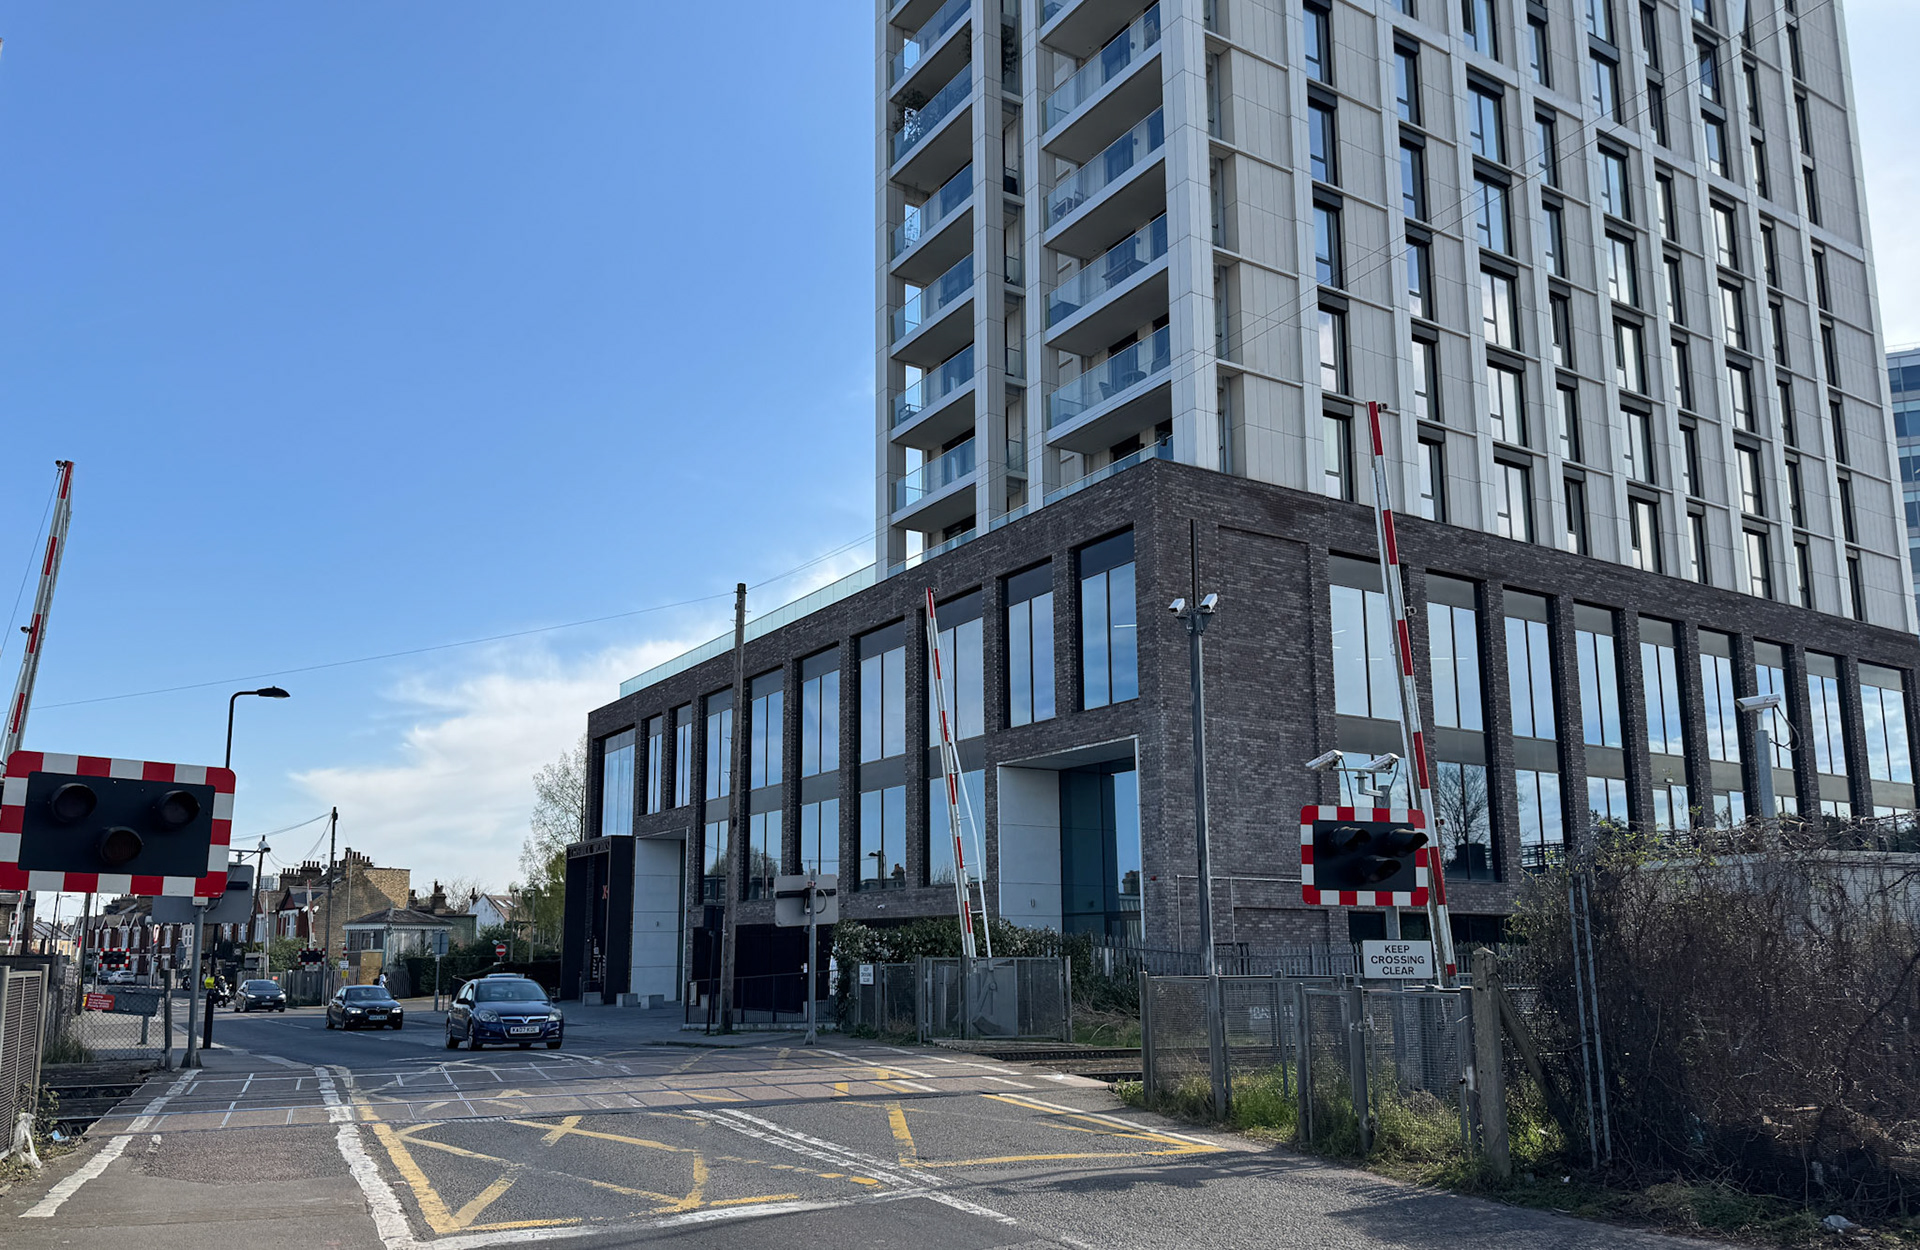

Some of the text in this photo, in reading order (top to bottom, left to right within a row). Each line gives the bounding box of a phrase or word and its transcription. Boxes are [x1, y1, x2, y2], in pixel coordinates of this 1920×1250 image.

[1384, 945, 1409, 953] KEEP
[1370, 955, 1425, 964] CROSSING
[1382, 966, 1414, 975] CLEAR
